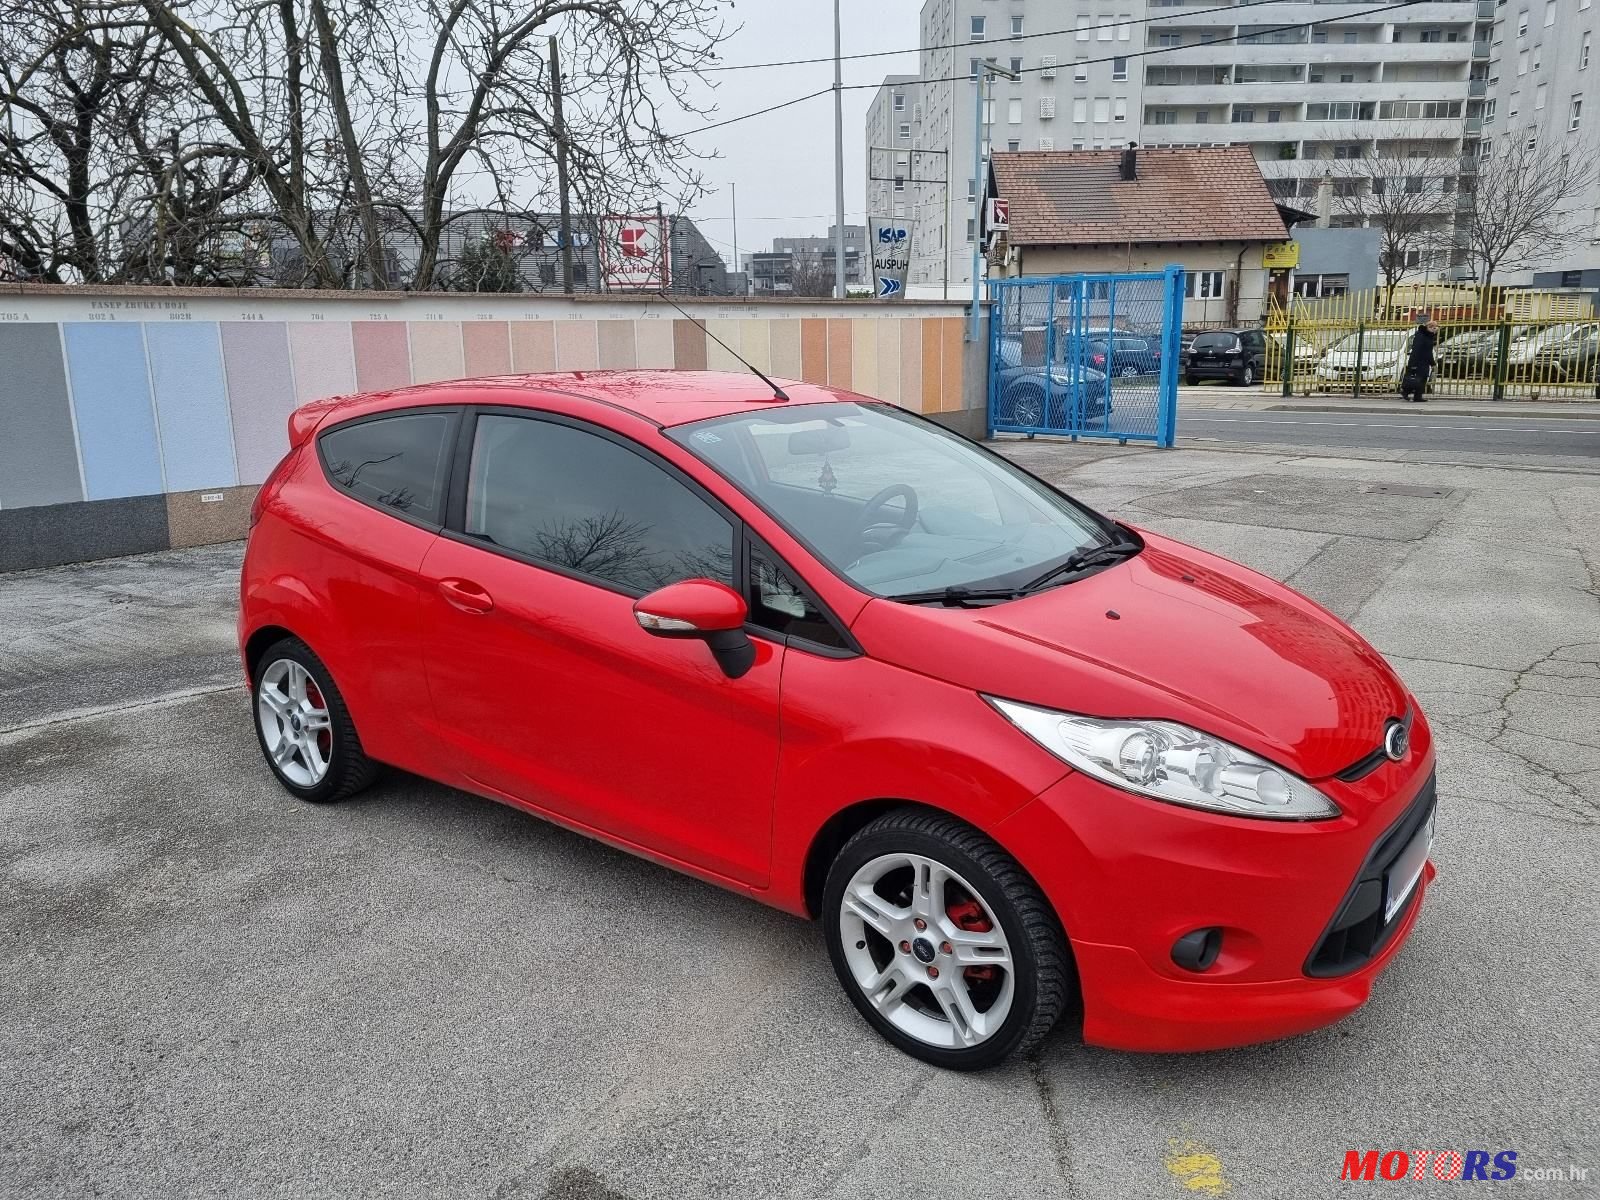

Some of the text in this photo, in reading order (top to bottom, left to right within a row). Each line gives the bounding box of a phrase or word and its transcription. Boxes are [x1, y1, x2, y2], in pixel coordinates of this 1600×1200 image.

[878, 227, 907, 244] ISAP
[874, 258, 909, 271] AUSPUH
[22, 312, 30, 321] A
